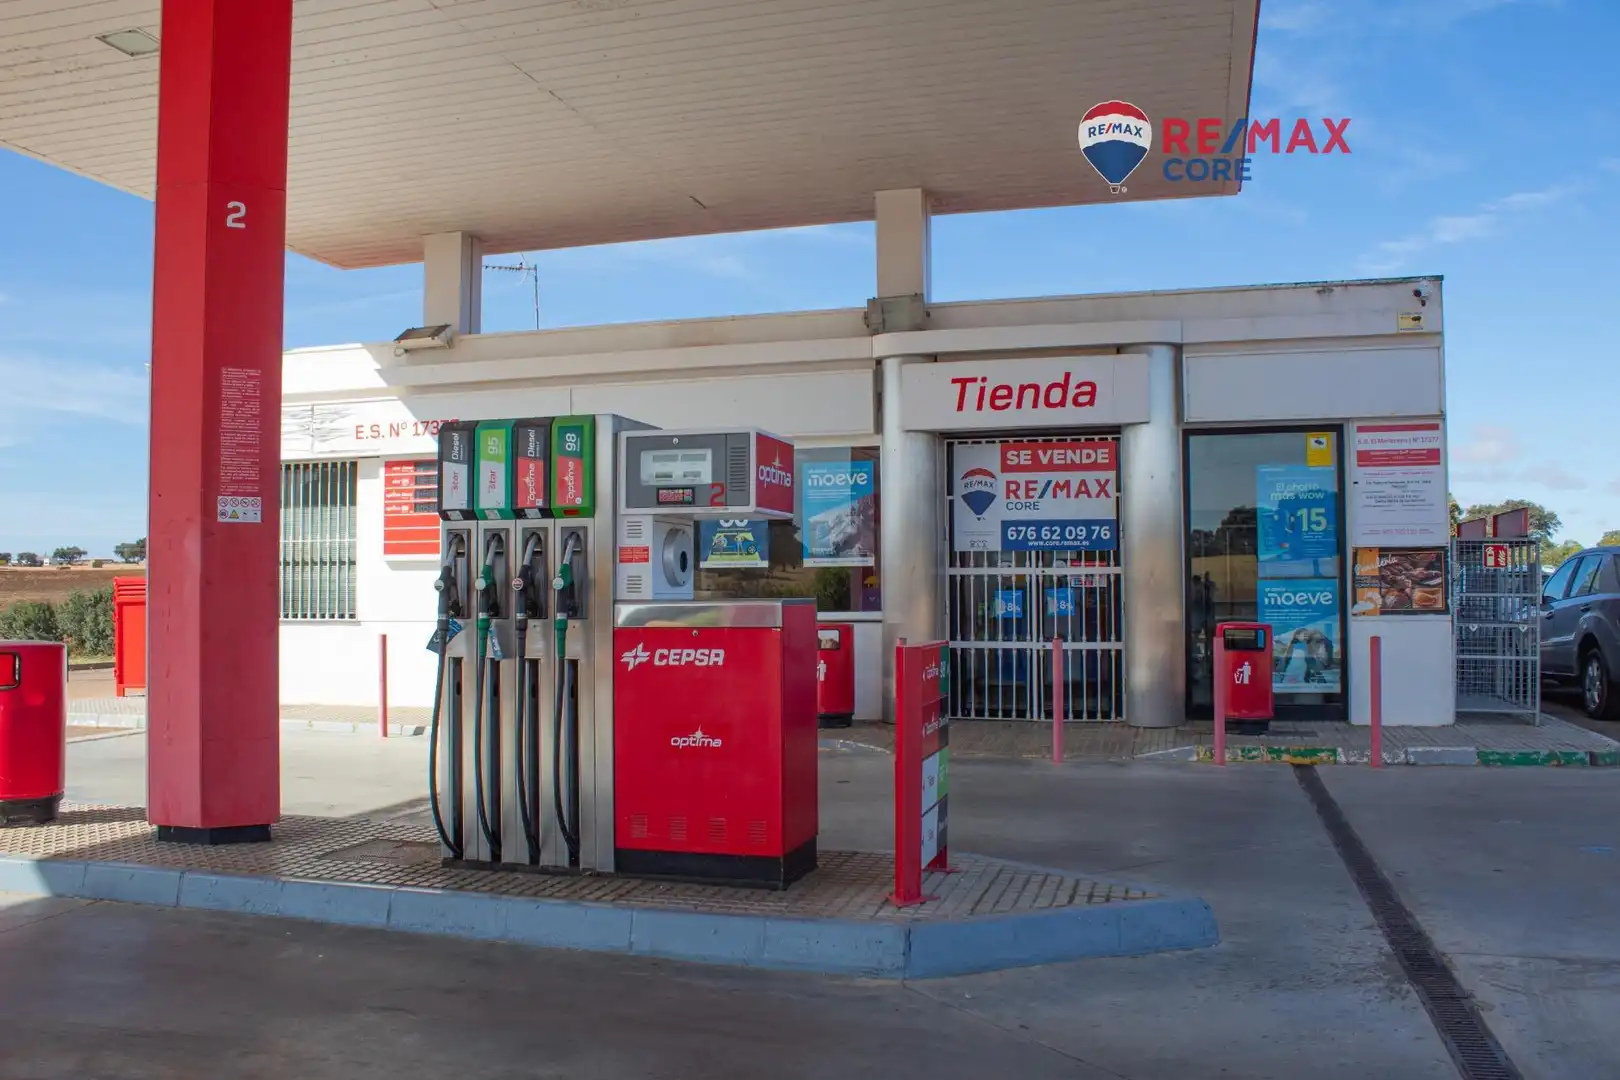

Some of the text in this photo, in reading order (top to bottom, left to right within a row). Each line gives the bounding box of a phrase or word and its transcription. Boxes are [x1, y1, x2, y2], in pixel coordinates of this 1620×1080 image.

[226, 201, 247, 229] 2
[950, 371, 1098, 412] Tienda
[355, 424, 385, 440] E.S.
[412, 418, 461, 437] 173
[451, 432, 460, 460] Diesel
[488, 436, 499, 454] 95
[527, 429, 536, 457] Diesel
[565, 432, 577, 452] 98
[1006, 448, 1110, 465] SE VENDE
[758, 464, 792, 489] optima
[808, 472, 868, 487] moeve
[963, 478, 994, 489] RE/MAX
[709, 482, 726, 508] 2
[1005, 478, 1112, 500] RE/MAX
[1006, 501, 1040, 511] CORE
[1296, 507, 1328, 532] 15
[1007, 527, 1037, 541] 676
[1041, 526, 1061, 540] 62
[1065, 526, 1087, 540] 09
[1091, 526, 1111, 539] 76
[1264, 591, 1333, 606] moeve
[653, 648, 725, 666] CEPSA
[670, 736, 722, 749] optima
